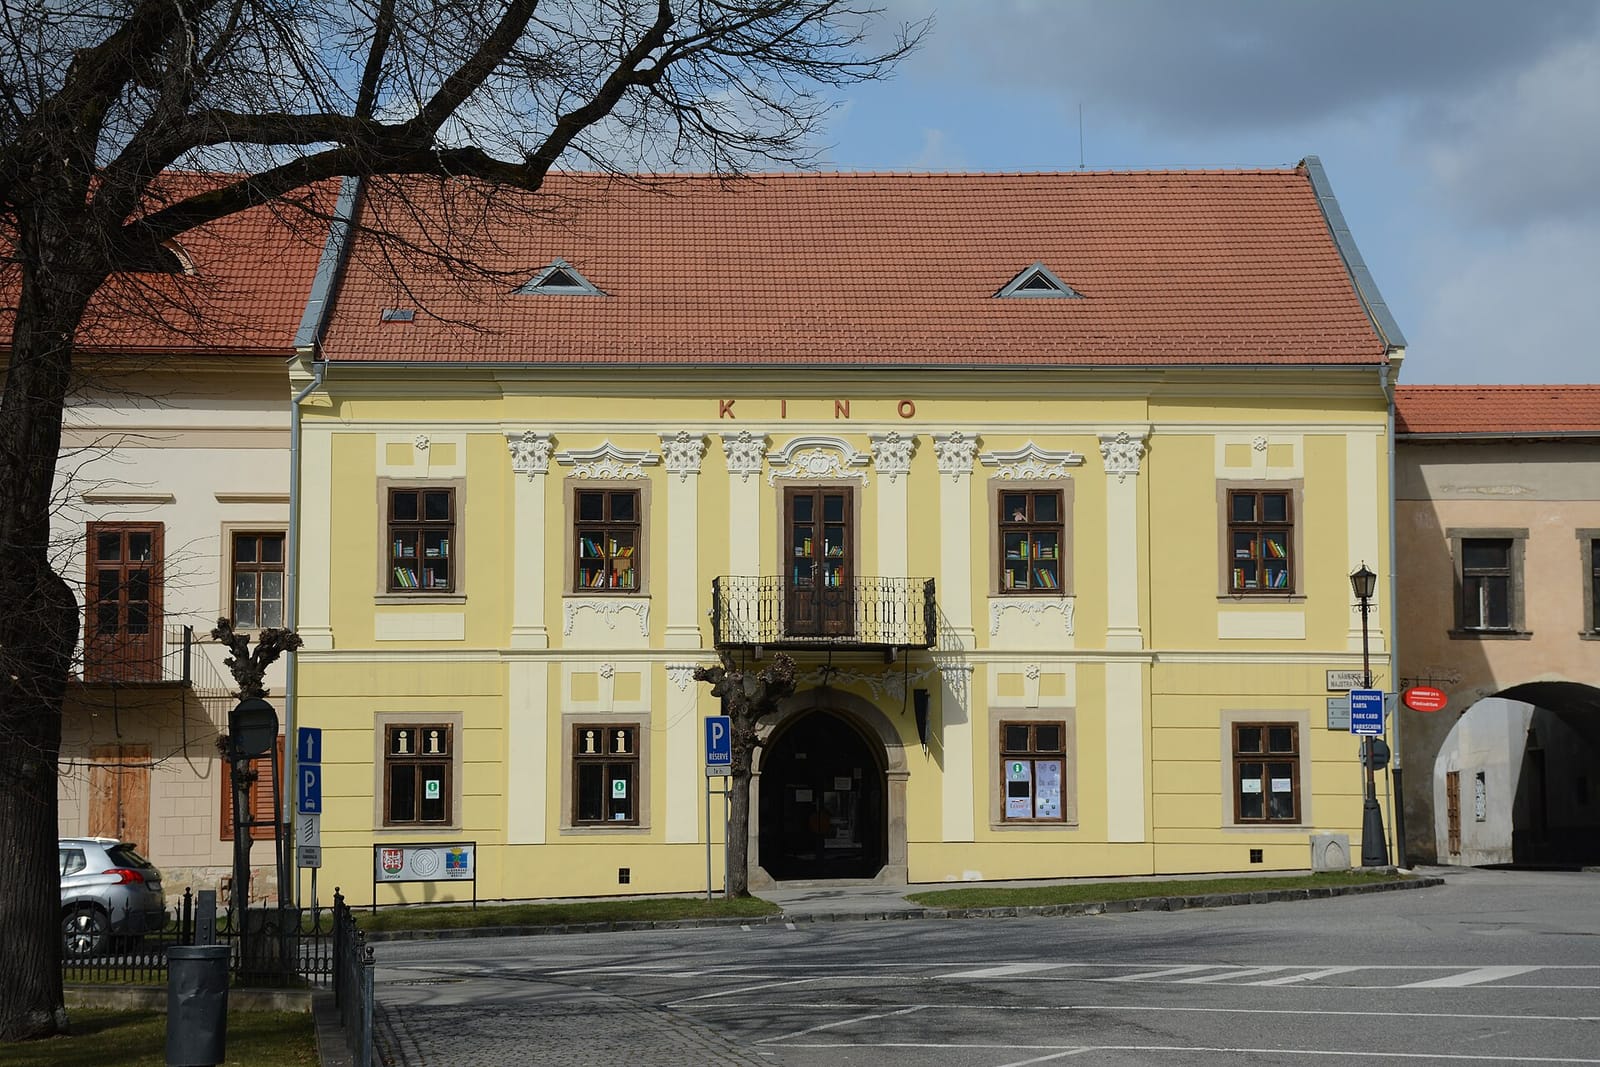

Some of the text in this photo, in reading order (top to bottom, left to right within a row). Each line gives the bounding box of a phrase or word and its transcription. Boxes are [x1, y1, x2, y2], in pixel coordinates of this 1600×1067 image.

[719, 399, 915, 419] KINO
[712, 722, 724, 750] P
[304, 770, 315, 797] P
